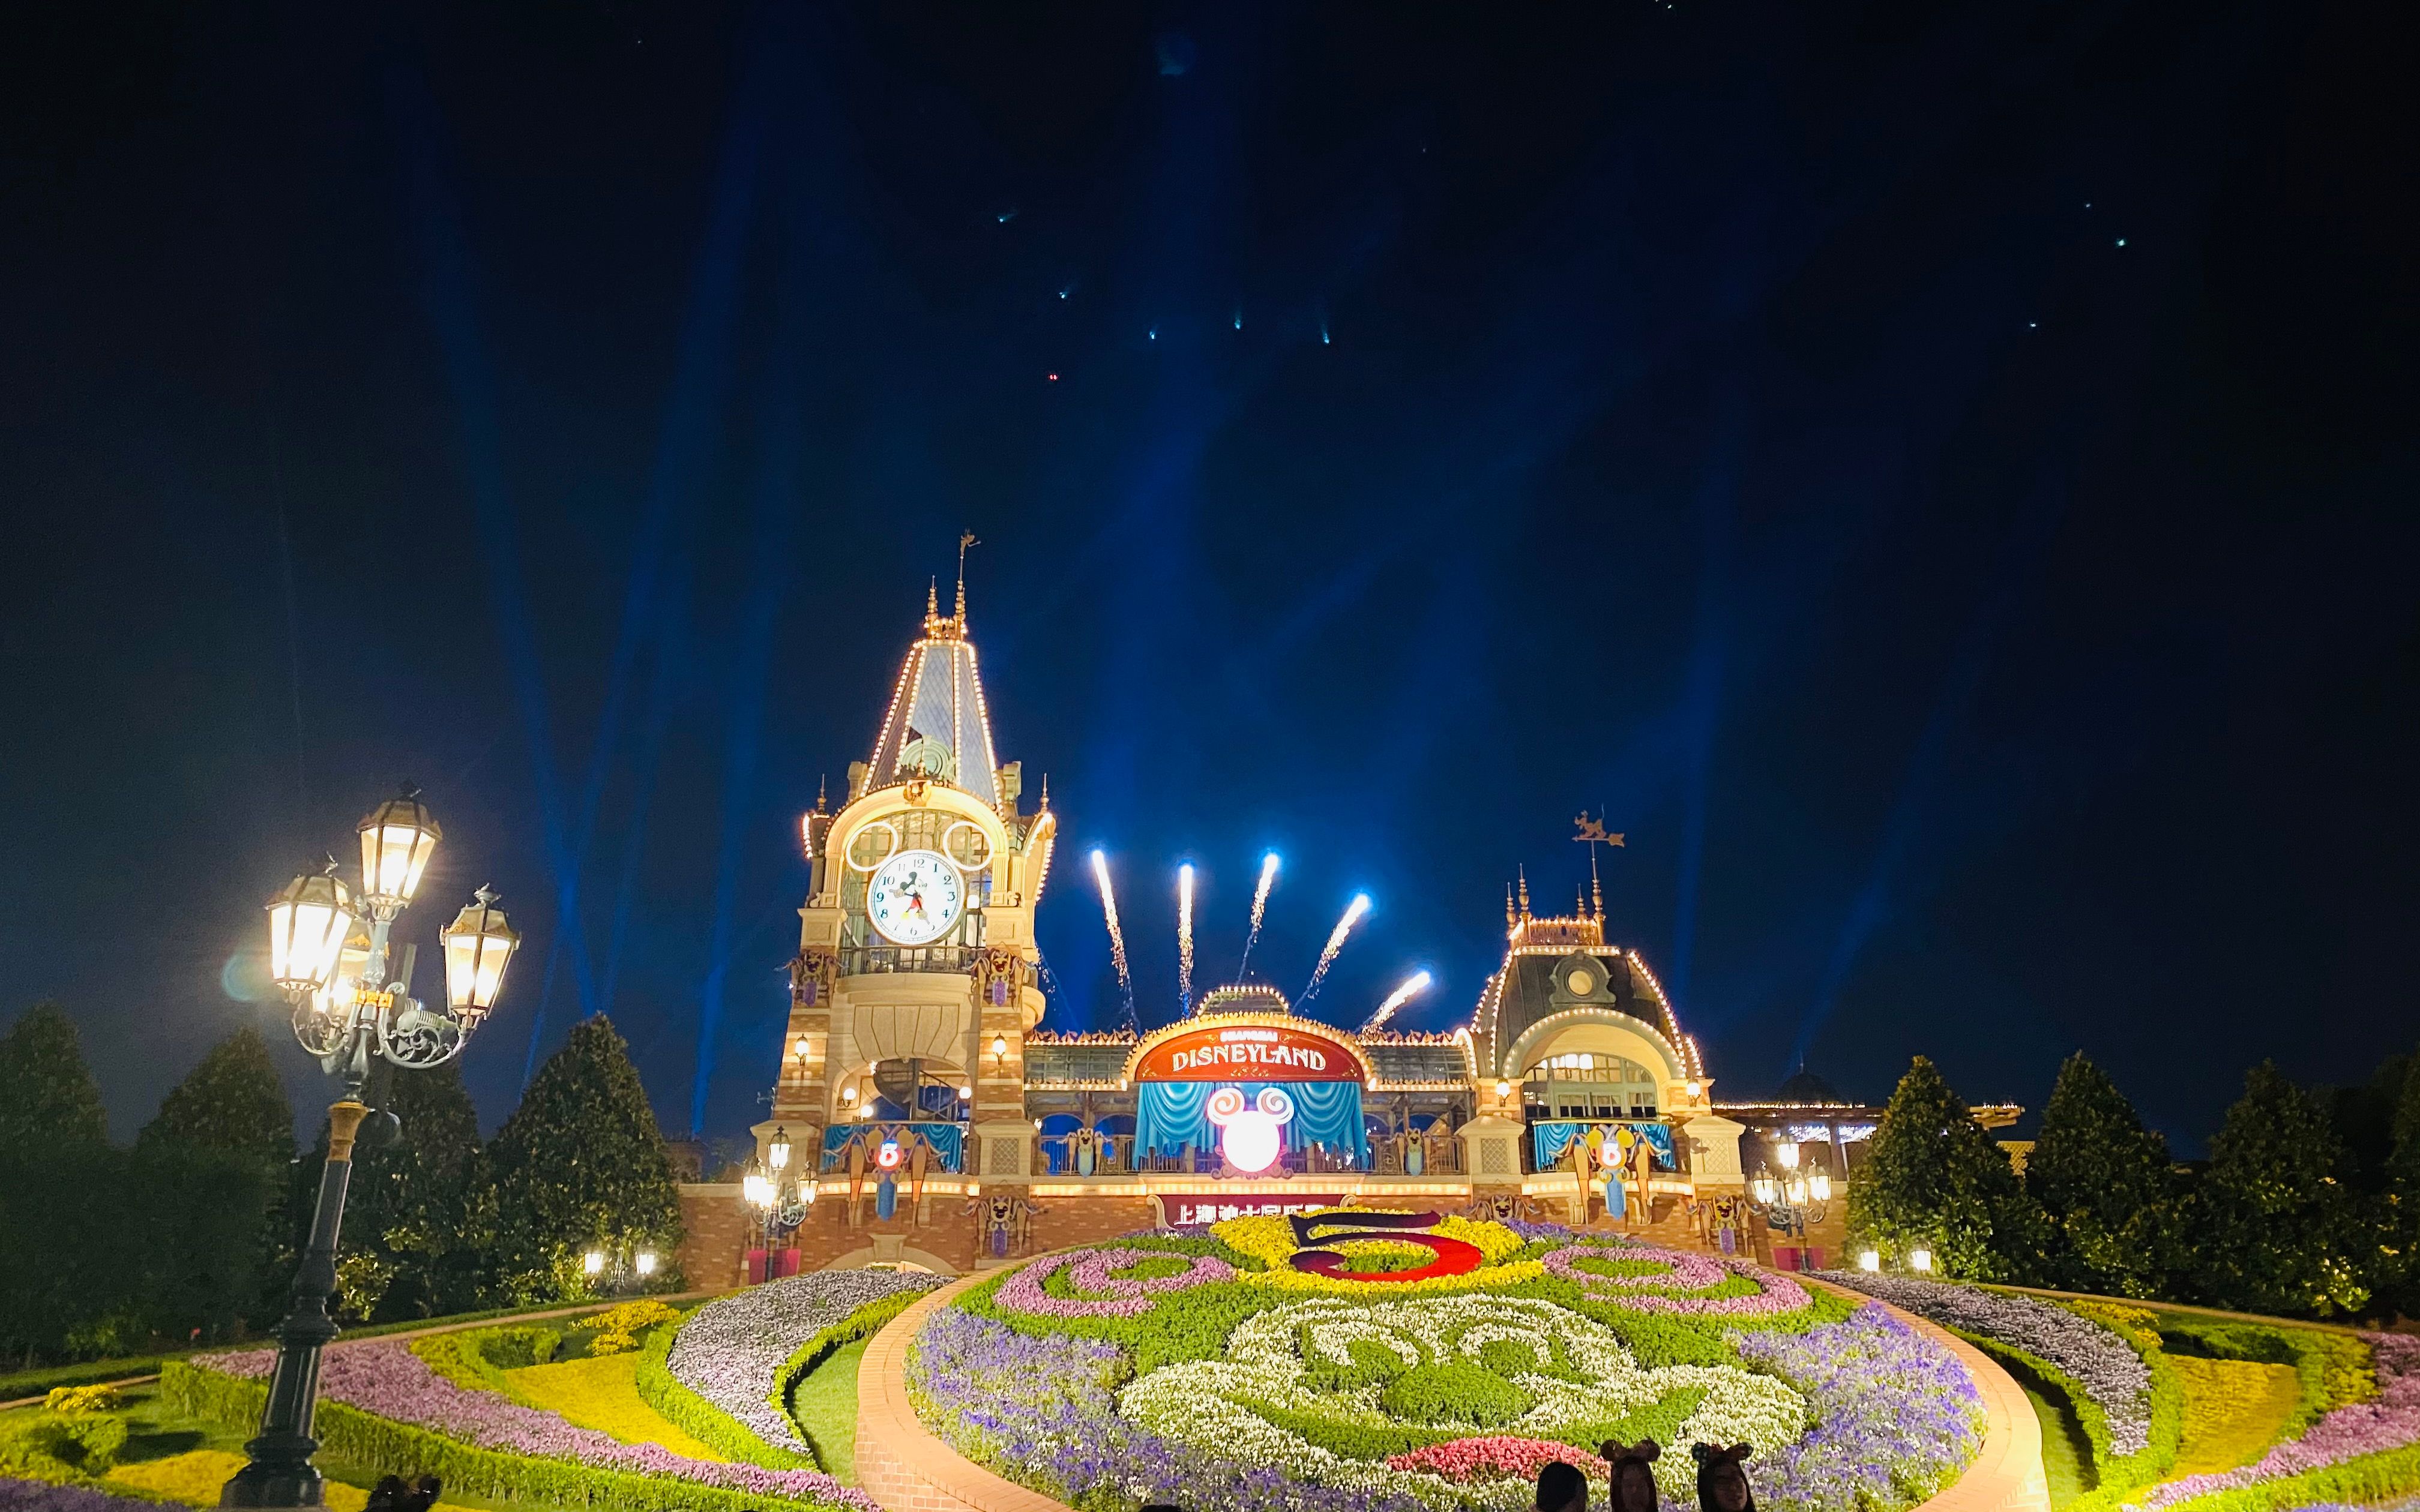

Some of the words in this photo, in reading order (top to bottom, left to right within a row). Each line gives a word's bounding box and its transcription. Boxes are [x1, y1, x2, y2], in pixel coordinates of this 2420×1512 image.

[914, 859, 925, 868] 12
[933, 863, 938, 873] 1
[882, 875, 895, 886] 10
[944, 875, 952, 885] 2
[876, 892, 884, 902] 9
[947, 891, 956, 901] 3
[880, 908, 888, 919] 8
[942, 909, 949, 918] 4
[911, 927, 917, 935] 6
[1172, 1043, 1326, 1072] DISNEYLAND
[1289, 1210, 1483, 1283] 5
